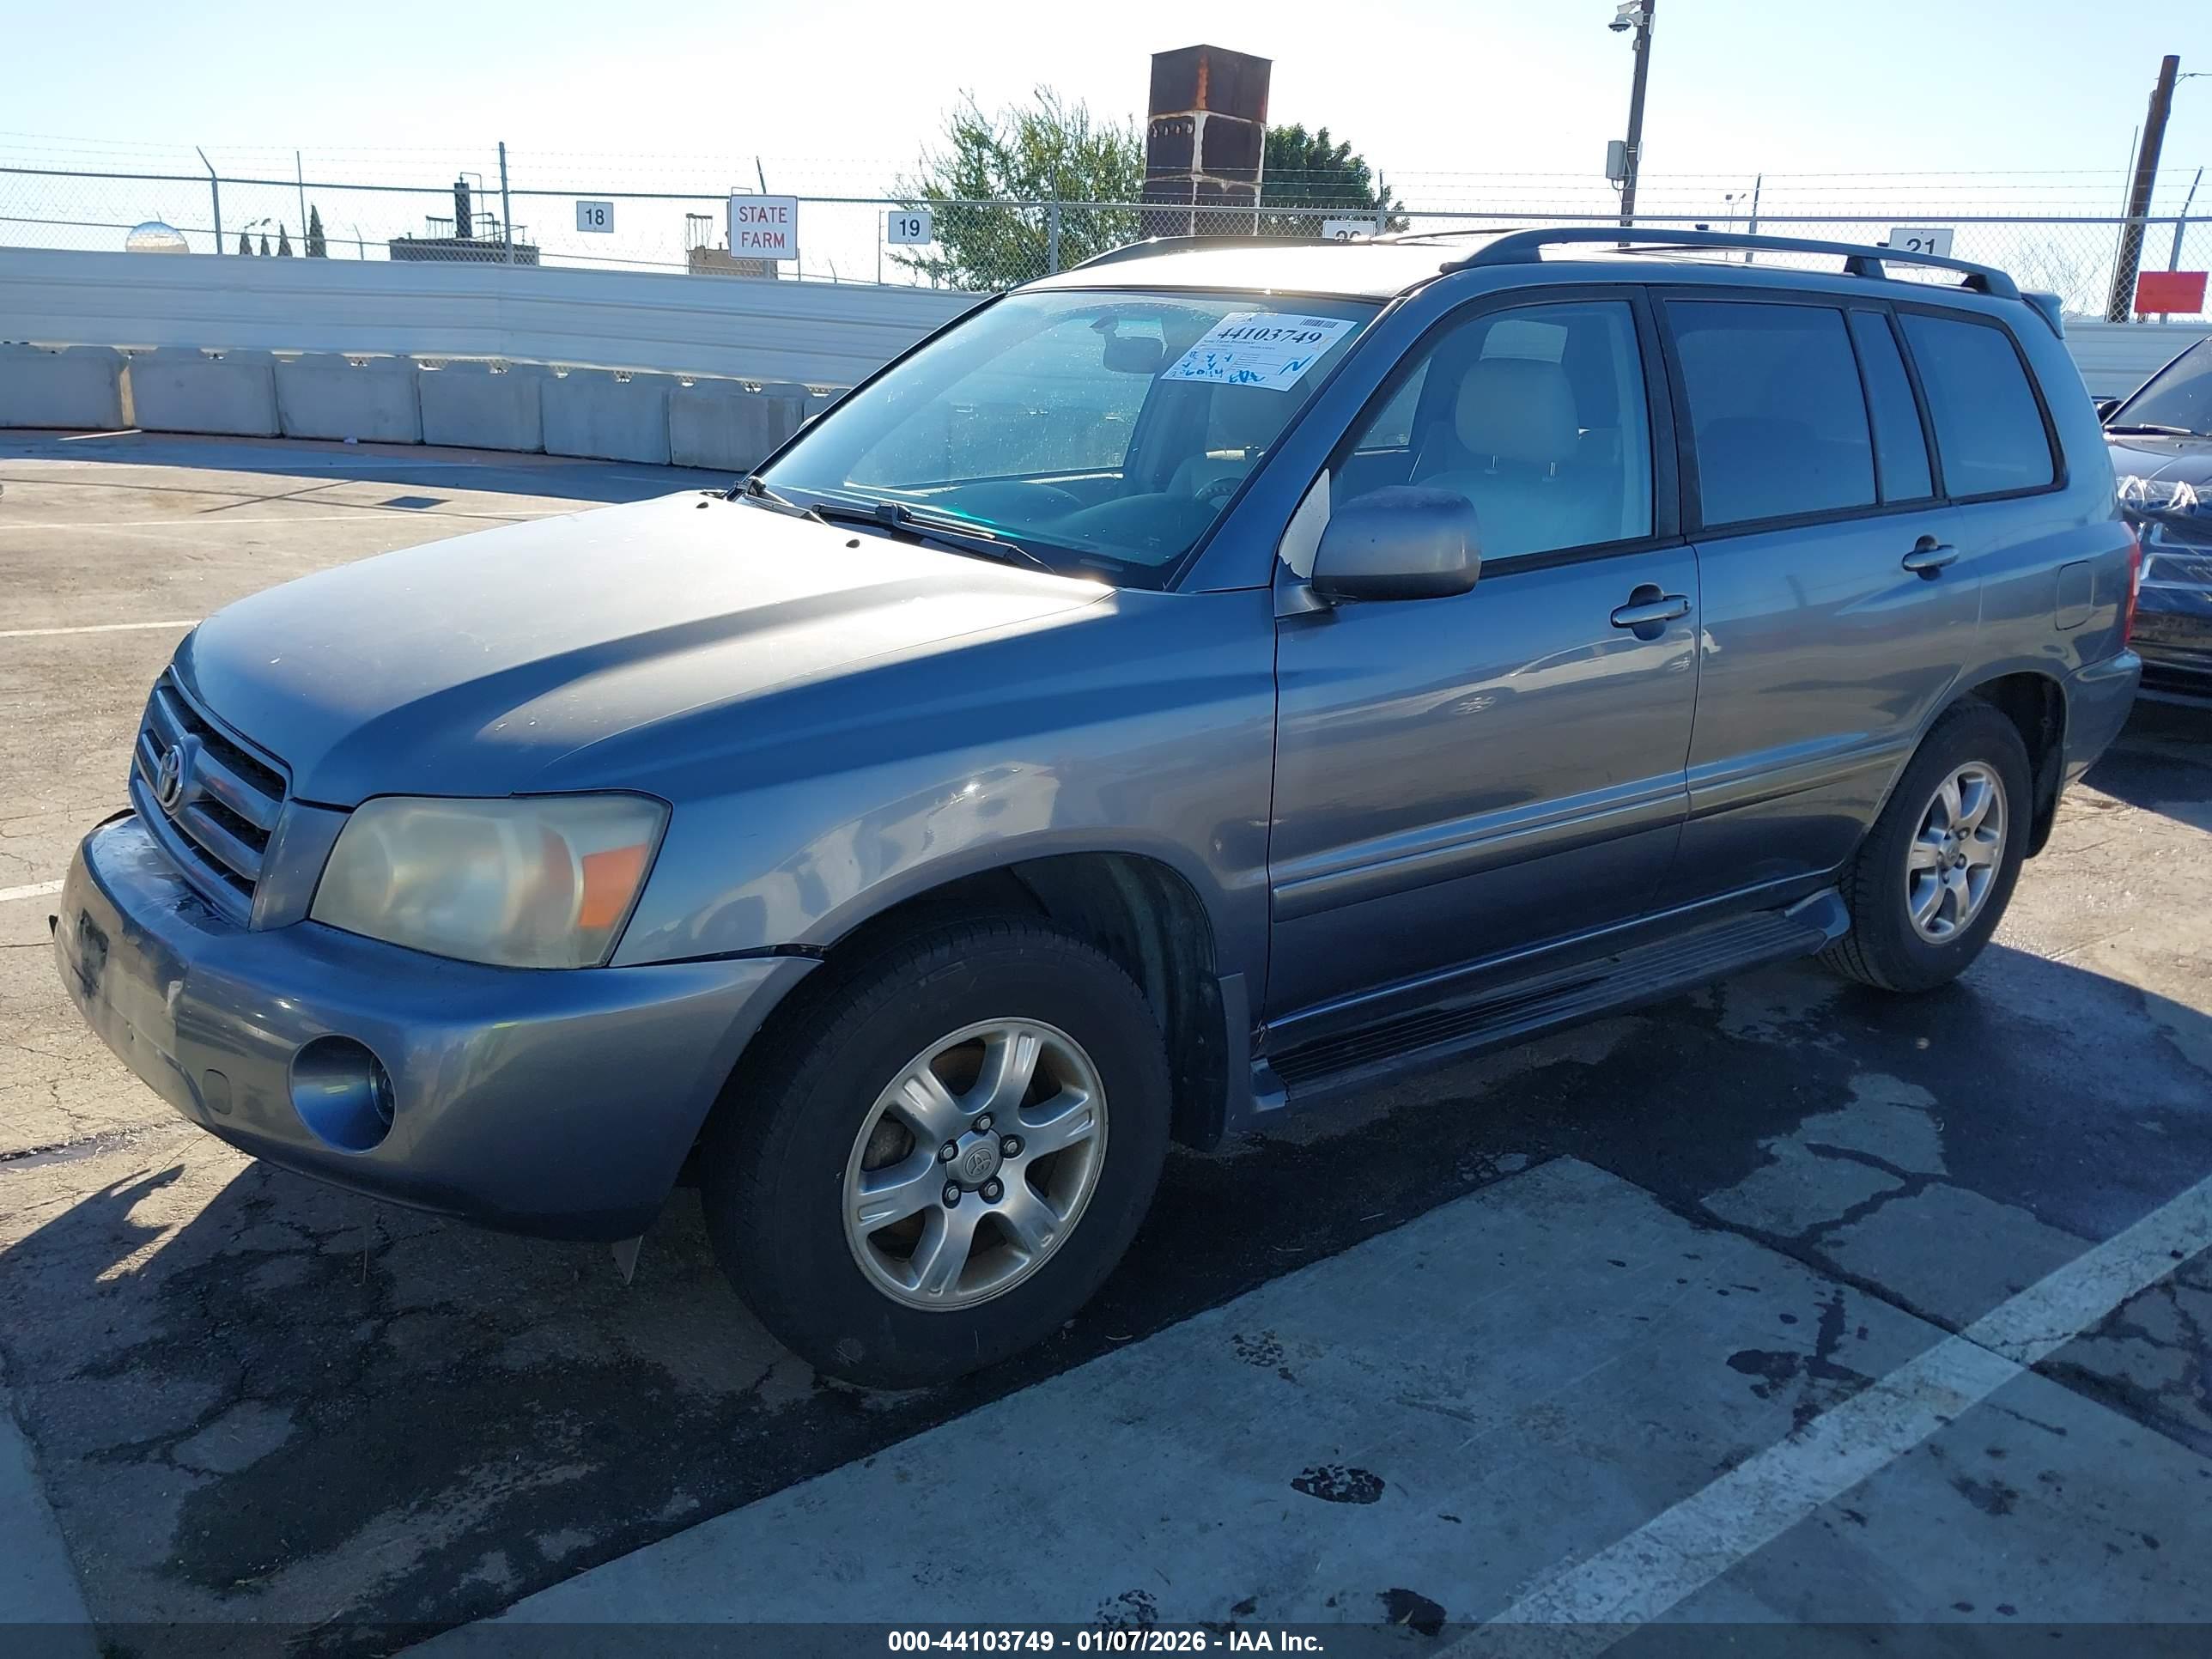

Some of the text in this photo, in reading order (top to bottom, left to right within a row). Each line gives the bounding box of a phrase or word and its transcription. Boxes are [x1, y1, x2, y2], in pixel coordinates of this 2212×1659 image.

[585, 208, 605, 226] 18
[738, 206, 788, 223] STATE
[899, 218, 921, 237] 19
[741, 232, 786, 249] FARM
[1218, 326, 1322, 344] 44103749
